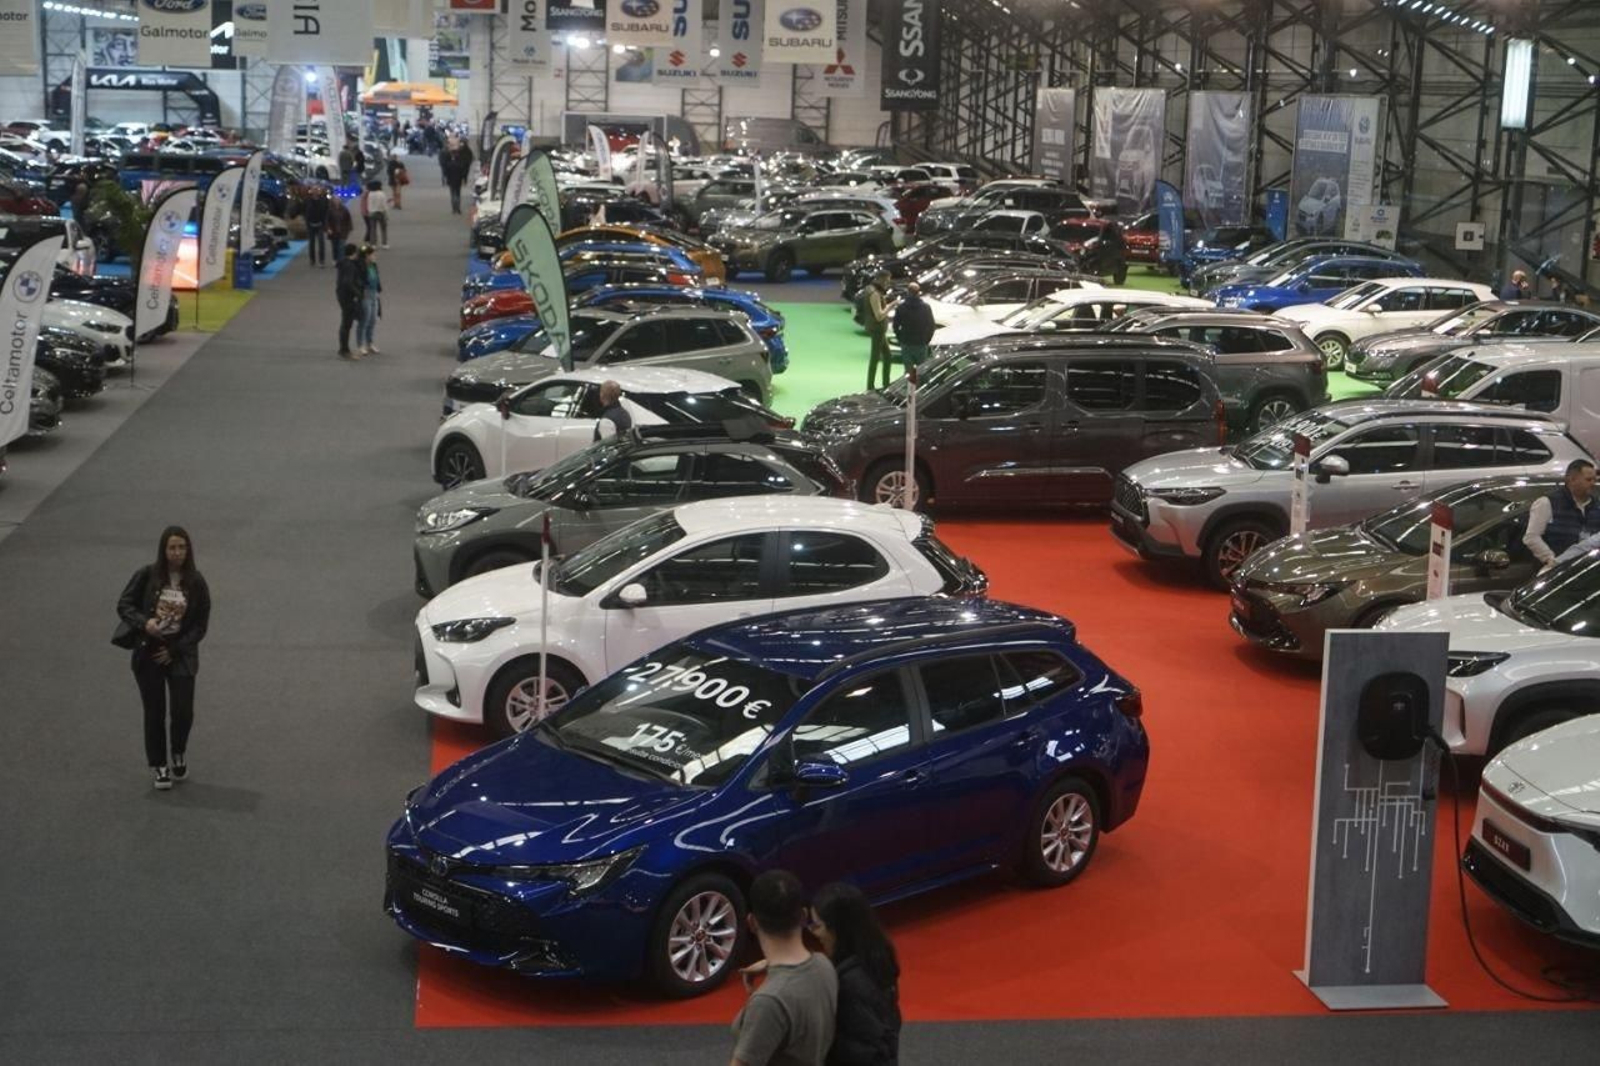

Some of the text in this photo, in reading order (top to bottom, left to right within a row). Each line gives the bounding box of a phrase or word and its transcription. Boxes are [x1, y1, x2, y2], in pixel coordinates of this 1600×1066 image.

[0, 11, 29, 20] otor
[673, 0, 687, 37] SU
[732, 0, 750, 40] SU
[140, 25, 208, 39] Galmotor
[611, 22, 669, 33] SUBARU
[769, 37, 832, 48] SUBARU
[90, 74, 136, 86] KIA
[657, 69, 697, 78] SUZUKI
[720, 69, 758, 78] SUZUKI
[884, 88, 937, 99] SSANGYONG
[0, 310, 29, 415] Celtamotor
[742, 699, 772, 719] €
[421, 889, 448, 905] COROLLA
[412, 891, 460, 918] TOURING SPORTS
